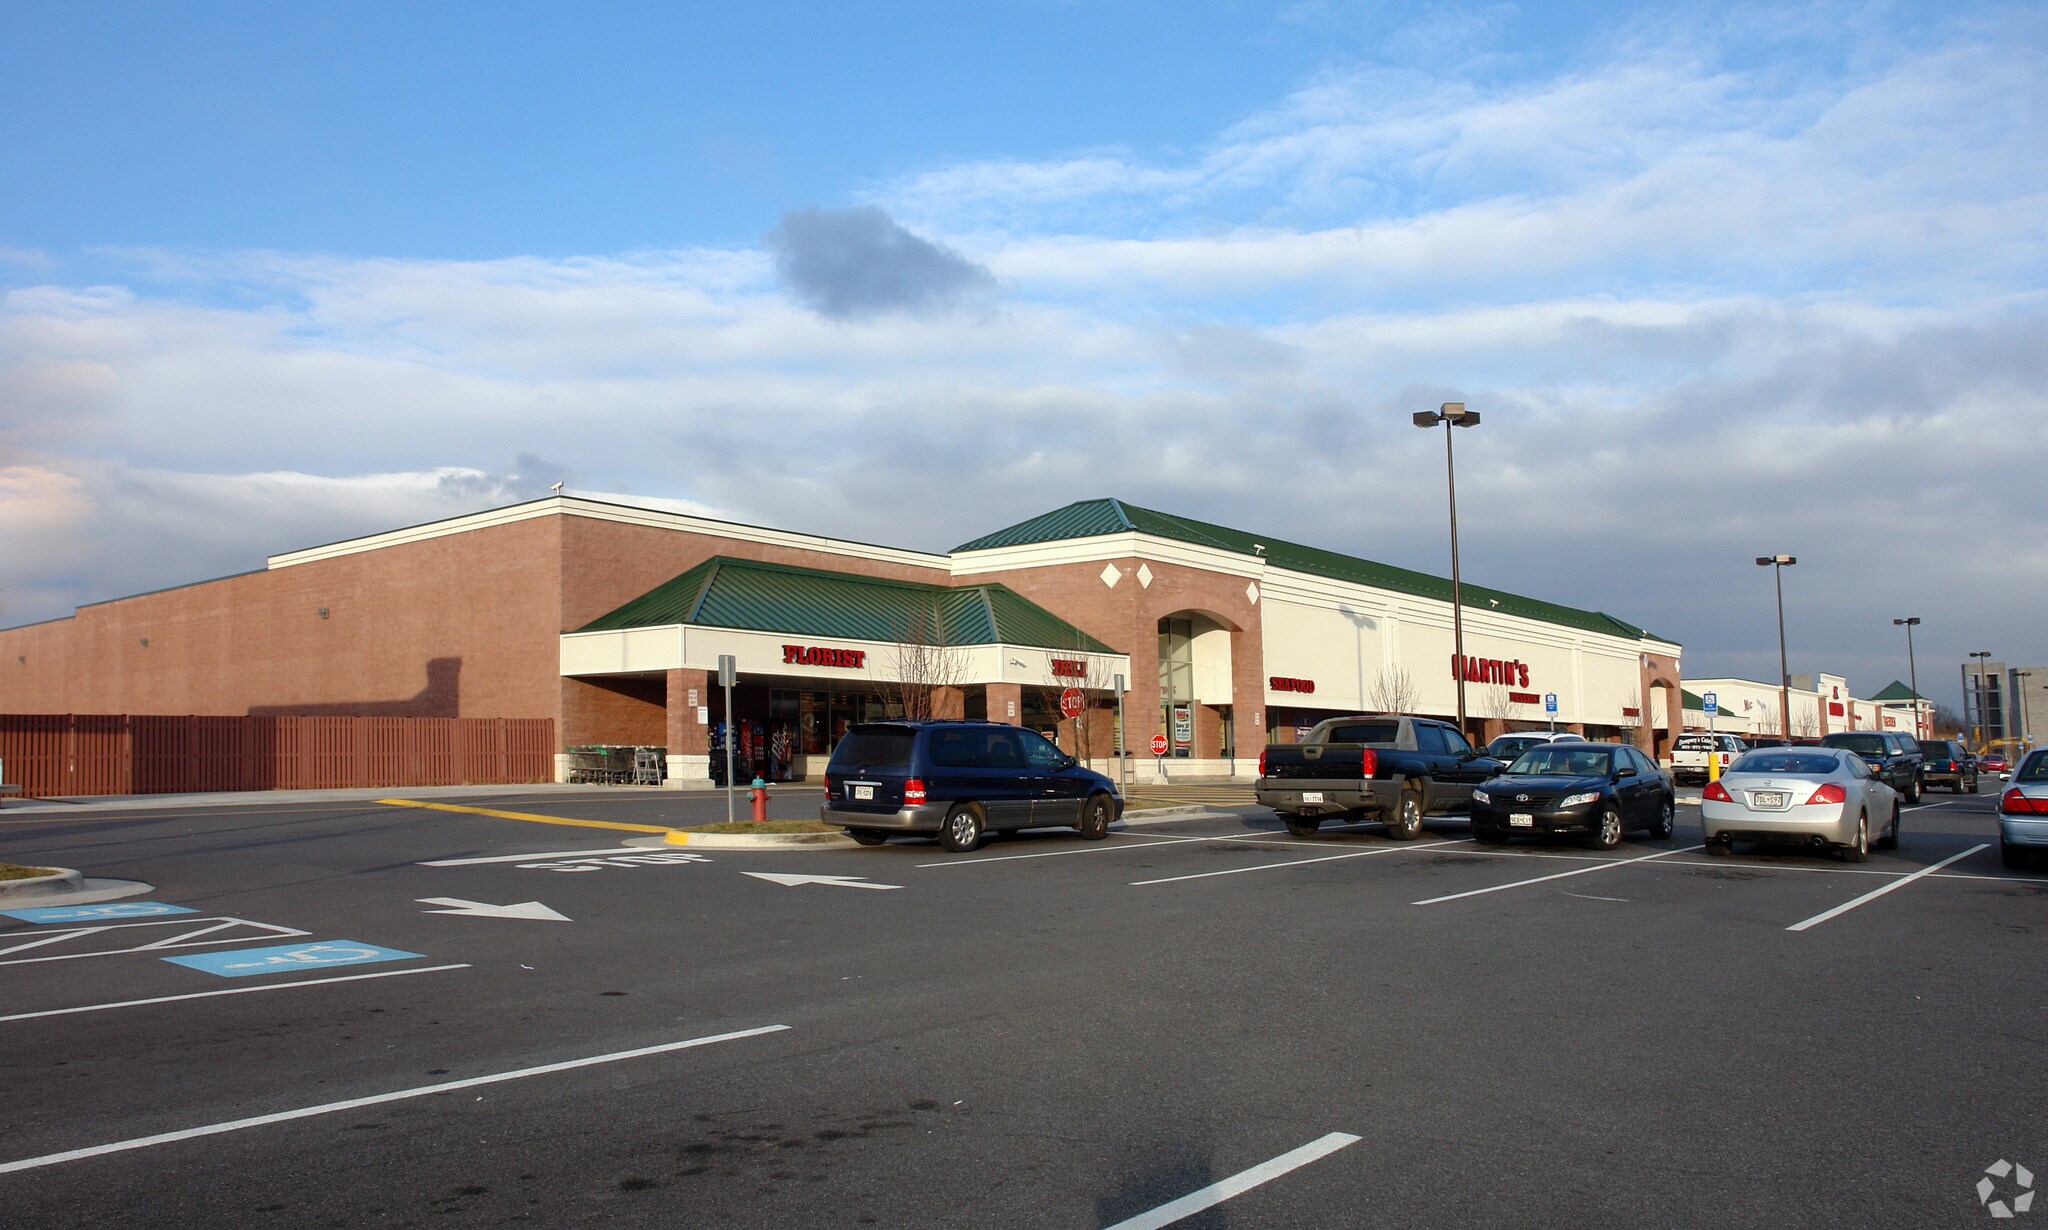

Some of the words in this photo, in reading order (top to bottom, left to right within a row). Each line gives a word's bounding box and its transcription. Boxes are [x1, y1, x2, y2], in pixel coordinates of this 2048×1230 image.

[782, 645, 866, 668] FLORIST
[1052, 659, 1088, 677] DELI
[1451, 653, 1530, 688] MARTIN'S
[1269, 676, 1316, 694] SEAFOOD
[1062, 696, 1083, 710] STOP
[1151, 740, 1167, 748] STOP
[514, 853, 714, 872] STOP
